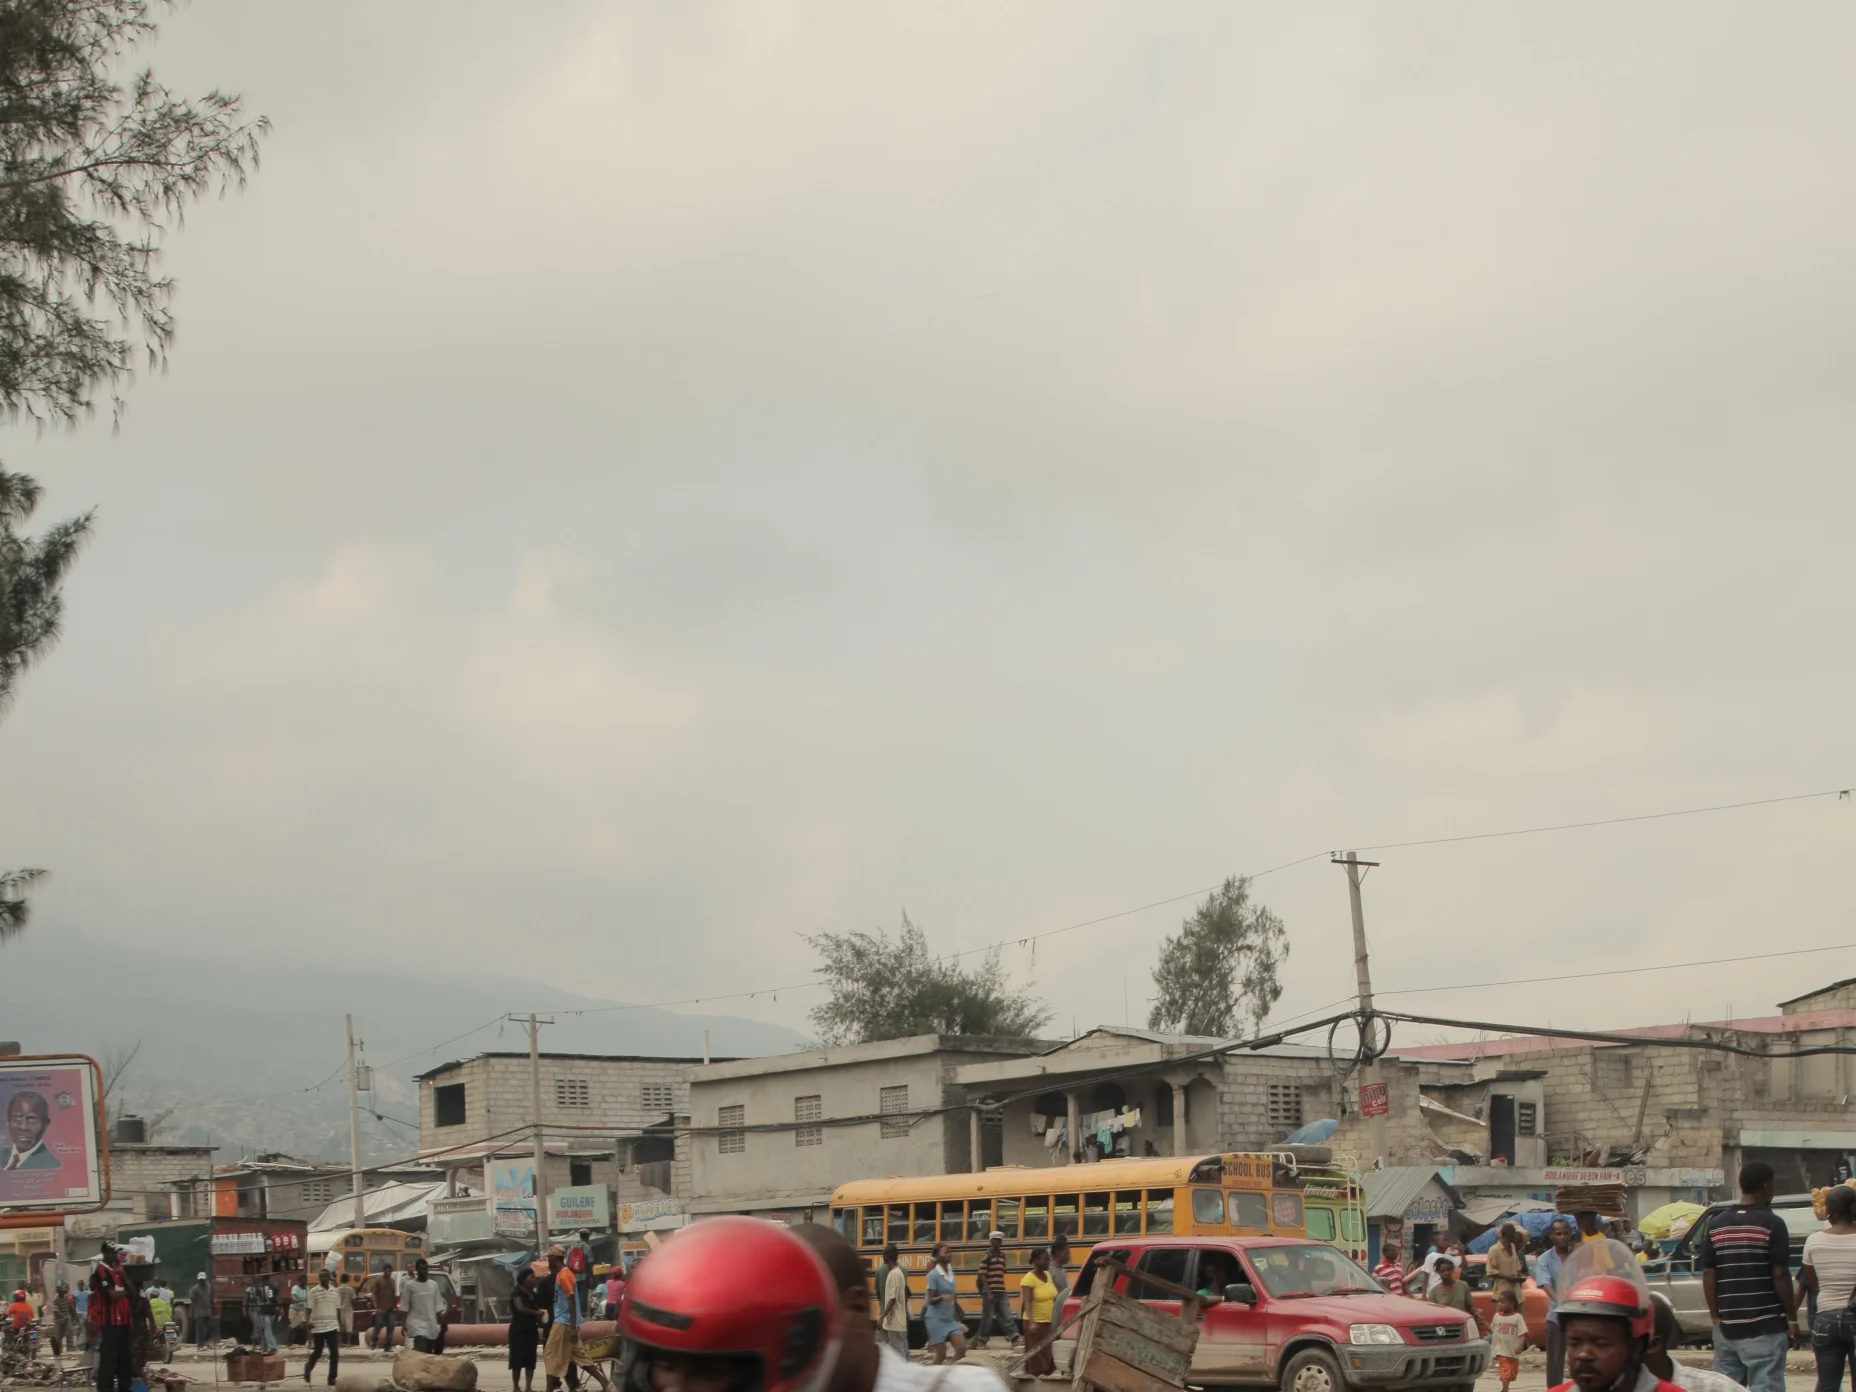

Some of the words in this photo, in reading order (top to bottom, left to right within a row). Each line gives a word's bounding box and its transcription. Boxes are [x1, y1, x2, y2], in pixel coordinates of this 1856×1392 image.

[1223, 1160, 1253, 1177] SCHOOL
[1256, 1163, 1271, 1178] BUS
[1587, 1171, 1599, 1181] BON
[560, 1196, 595, 1208] GUILENE
